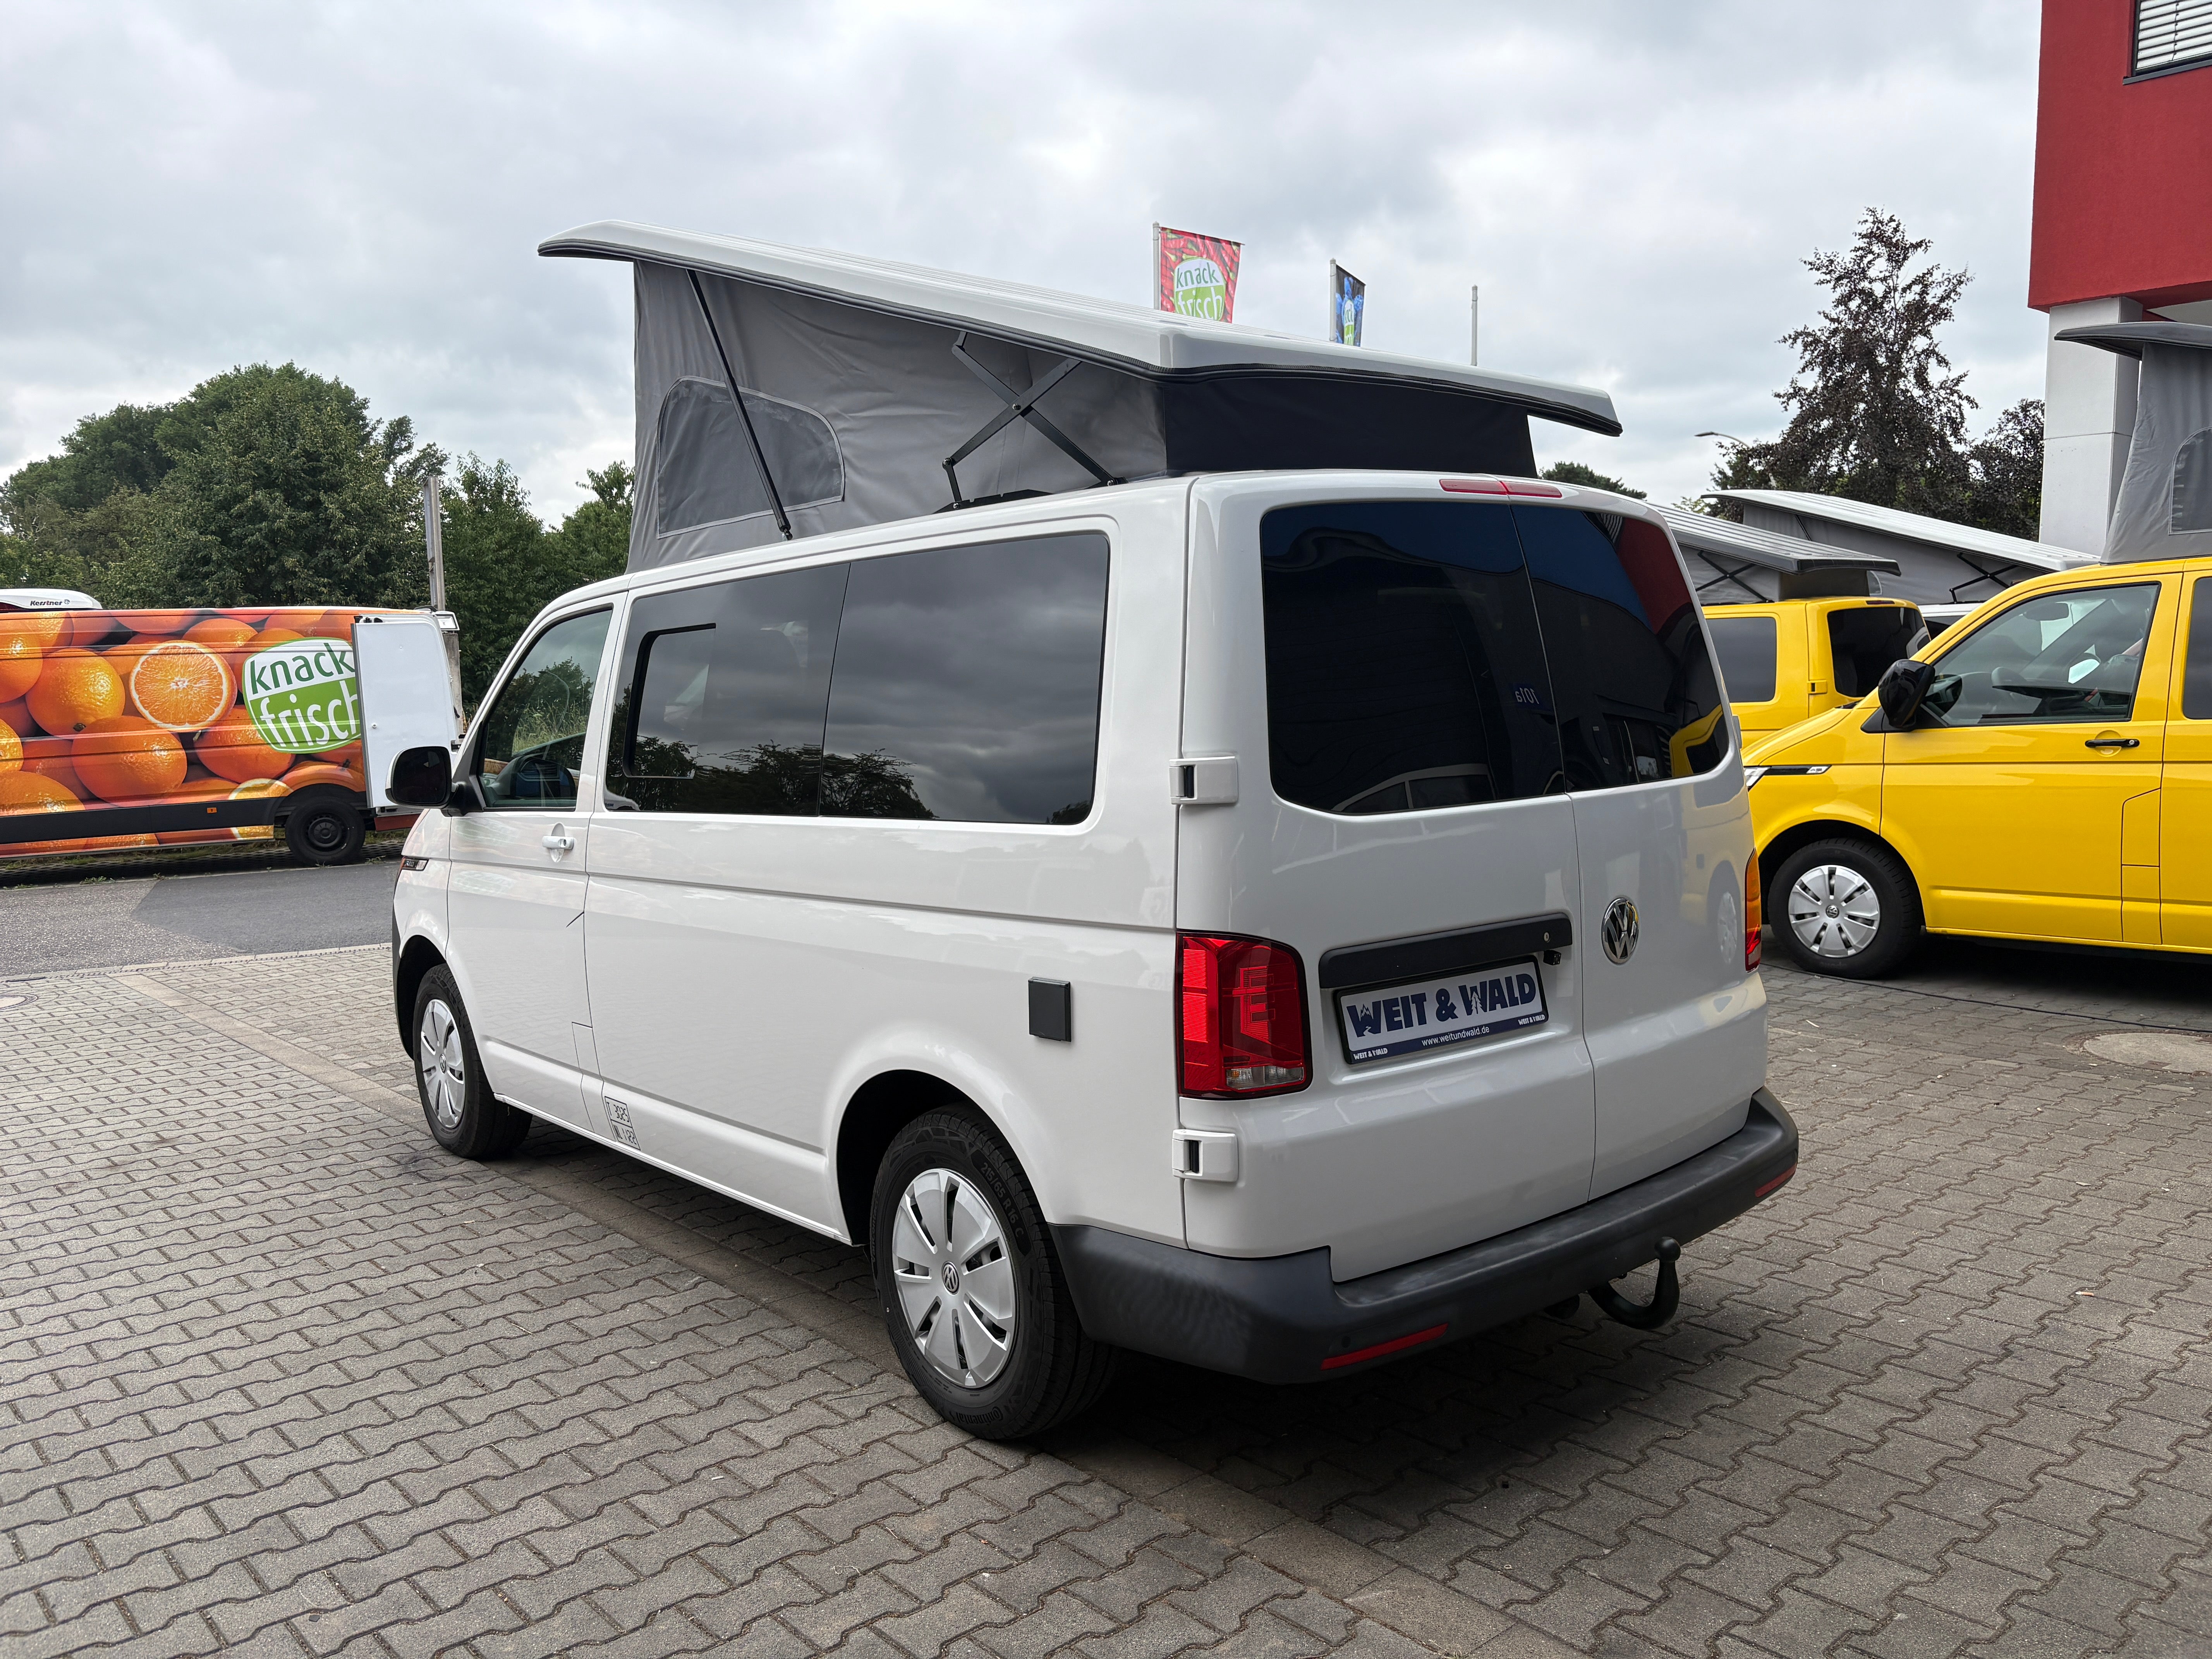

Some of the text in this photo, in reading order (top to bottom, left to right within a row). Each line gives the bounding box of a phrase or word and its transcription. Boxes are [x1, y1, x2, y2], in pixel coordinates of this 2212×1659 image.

[1177, 262, 1219, 288] knack
[1178, 287, 1222, 320] frisch
[250, 643, 355, 694] knack
[1346, 974, 1536, 1037] WEIT & WALD
[1422, 1026, 1490, 1046] www.weitundwald.de
[1373, 1048, 1388, 1056] WALD
[981, 1162, 1006, 1197] 215/65
[1015, 1227, 1024, 1238] C
[956, 1407, 1003, 1424] Continental
